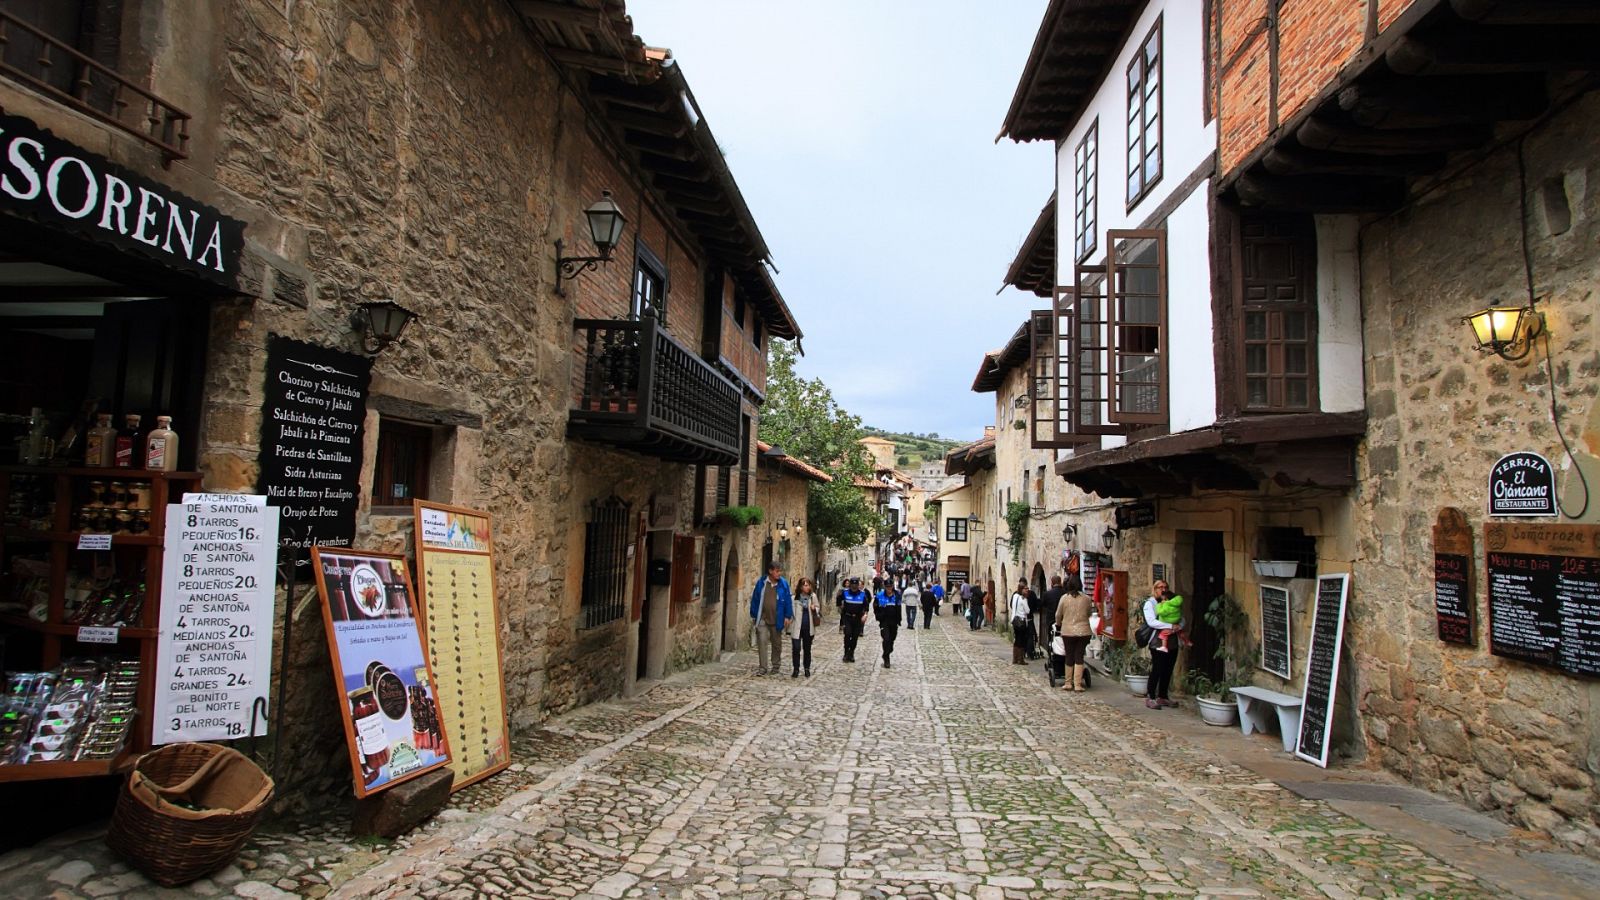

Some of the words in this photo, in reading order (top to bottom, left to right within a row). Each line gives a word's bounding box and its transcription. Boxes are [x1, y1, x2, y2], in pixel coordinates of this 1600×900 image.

[1, 137, 225, 273] SORENA
[279, 371, 312, 389] Chorizo
[314, 382, 320, 393] y
[321, 380, 360, 398] Salchichón
[286, 389, 295, 400] de
[297, 391, 324, 406] Ciervo
[325, 400, 330, 410] y
[274, 408, 316, 425] Salchichón
[318, 415, 326, 426] de
[328, 417, 352, 430] Ciervo
[353, 423, 359, 433] y
[310, 429, 317, 440] la
[319, 429, 350, 444] Pimienta
[276, 445, 305, 459] Piedras
[307, 448, 315, 459] de
[317, 450, 351, 463] Santillana
[1496, 458, 1544, 475] TERRAZA
[285, 466, 306, 478] Sidra
[309, 468, 342, 480] Asturiana
[1514, 471, 1525, 484] El
[268, 485, 286, 497] Miel
[288, 487, 296, 497] de
[298, 487, 317, 498] Brezo
[319, 490, 324, 501] y
[325, 488, 353, 501] Eucalipto
[1494, 480, 1548, 501] Ojáncano
[197, 494, 247, 503] ANCHOAS
[1497, 500, 1546, 508] RESTAURANTE
[187, 504, 201, 513] DE
[210, 503, 258, 514] SANTOÑA
[282, 505, 307, 521] Orujo
[309, 507, 318, 517] de
[319, 507, 338, 517] Potes
[187, 515, 197, 527] 8
[200, 518, 238, 527] TARROS
[307, 524, 312, 535] y
[182, 531, 237, 541] PEQUEÑOS
[302, 538, 312, 548] de
[314, 536, 349, 547] Legumbres
[193, 543, 243, 552] ANCHOAS
[184, 554, 198, 562] DE
[207, 552, 255, 562] SANTOÑA
[184, 565, 193, 577] 8
[196, 567, 234, 576] TARROS
[178, 580, 234, 590] PEQUEÑOS
[189, 594, 238, 602] ANCHOAS
[179, 604, 193, 613] DE
[203, 603, 250, 613] SANTOÑA
[177, 616, 186, 628] 4
[191, 618, 230, 626] TARROS
[173, 629, 226, 641] MEDIANOS
[185, 642, 235, 651] ANCHOAS
[176, 654, 190, 663] DE
[200, 651, 247, 662] SANTOÑA
[175, 666, 184, 678] 4
[188, 667, 227, 676] TARROS
[170, 681, 218, 691] GRANDES
[190, 692, 228, 702] BONITO
[176, 705, 197, 714] DEL
[206, 702, 240, 711] NORTE
[171, 718, 181, 731] 3
[184, 718, 226, 728] TARROS
